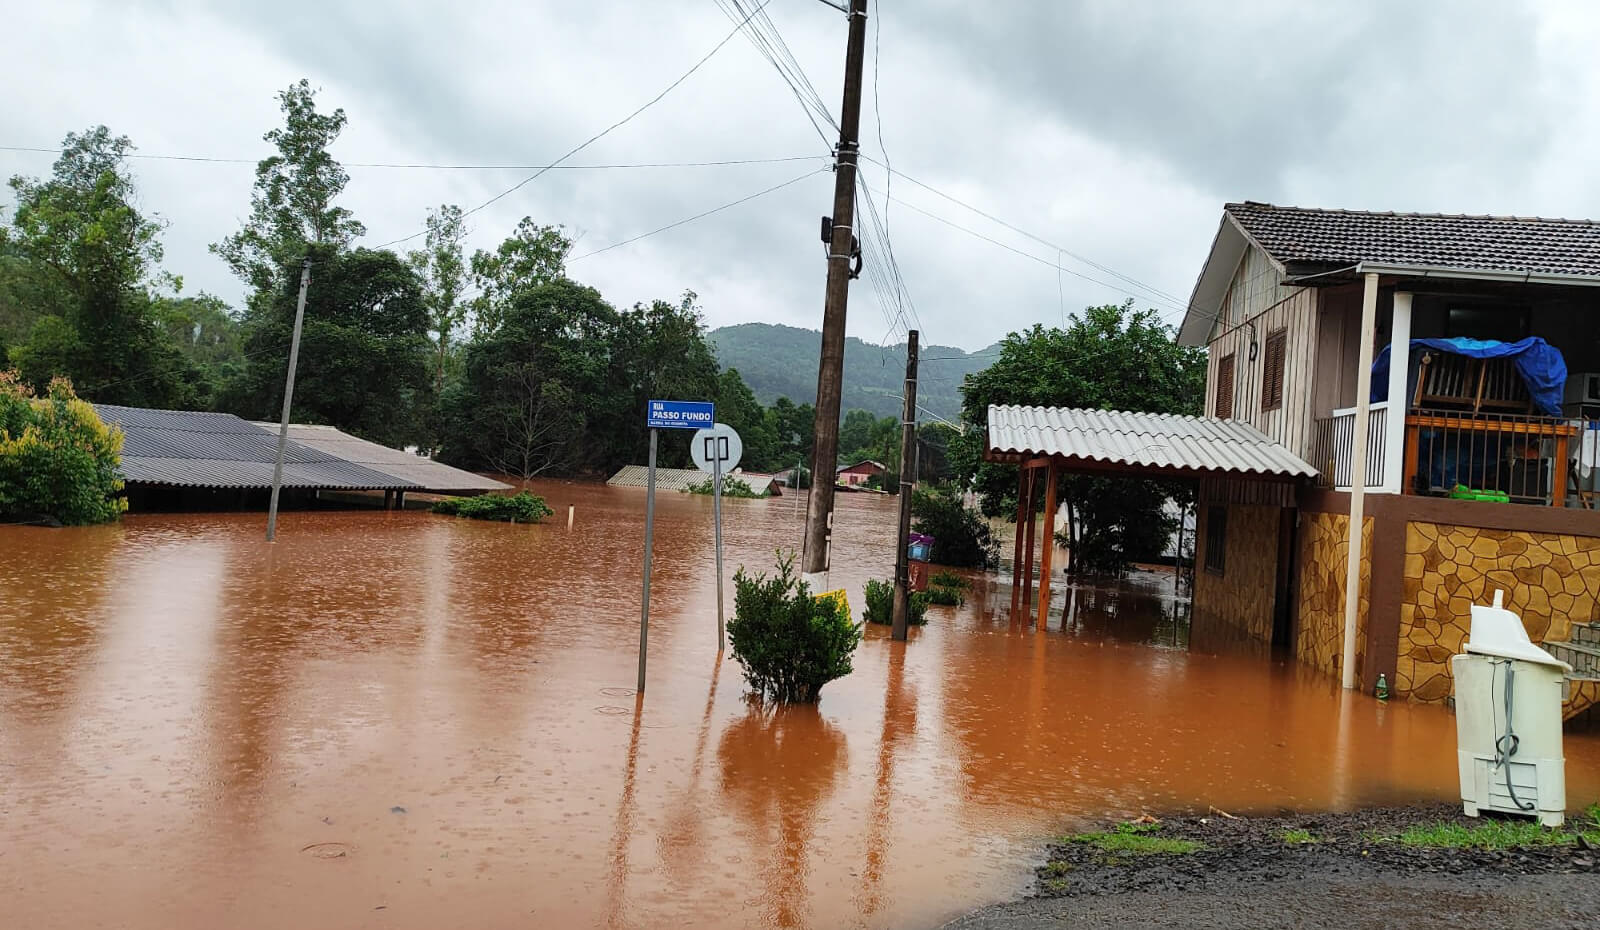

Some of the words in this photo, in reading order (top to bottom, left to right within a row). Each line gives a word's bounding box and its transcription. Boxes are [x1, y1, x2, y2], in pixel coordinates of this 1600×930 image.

[653, 402, 664, 411] RUA
[652, 411, 680, 420] PASSO
[681, 412, 711, 421] FUNDO
